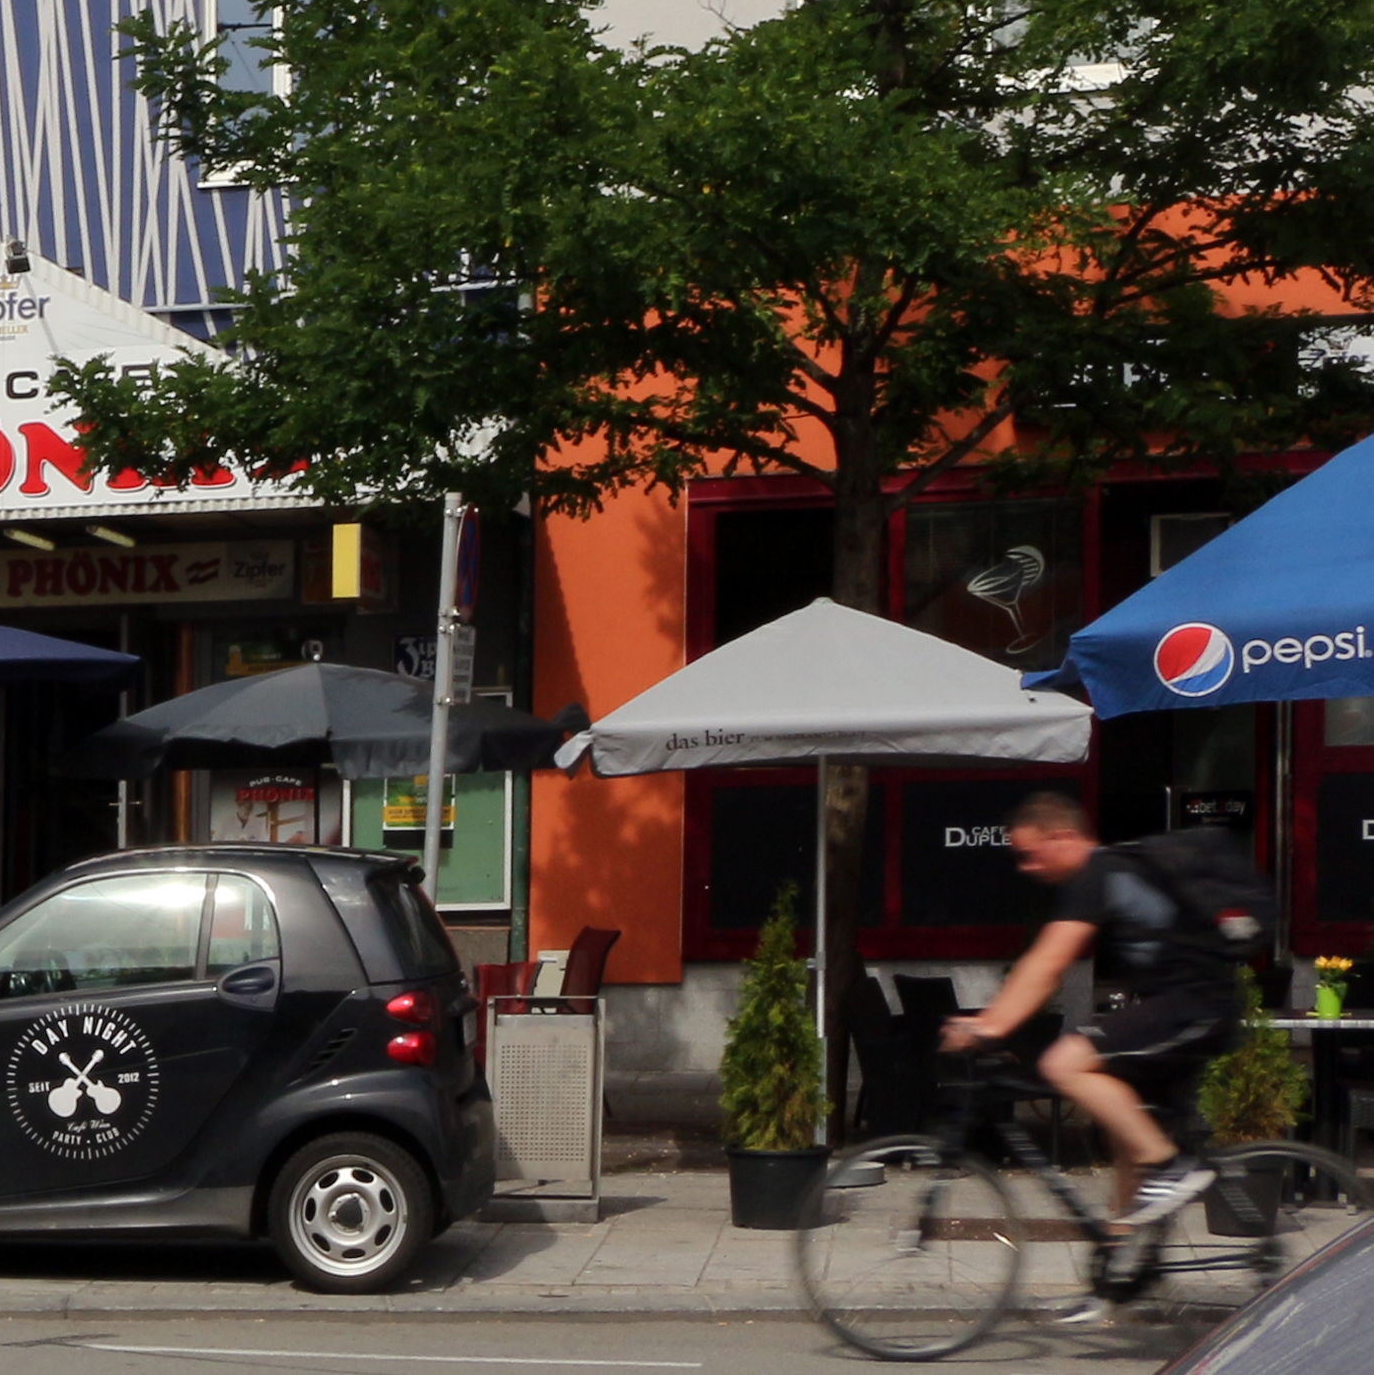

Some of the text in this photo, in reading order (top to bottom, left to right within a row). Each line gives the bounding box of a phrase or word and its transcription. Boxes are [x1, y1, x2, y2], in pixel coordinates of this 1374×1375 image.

[7, 553, 181, 597] PHÖNIX
[234, 560, 286, 582] Zipfer
[1242, 625, 1365, 674] pepsi
[666, 733, 698, 751] das
[704, 728, 744, 747] bier
[944, 827, 1013, 847] DUPLE
[31, 1016, 137, 1055] DAY NIGHT
[28, 1073, 140, 1093] SEIT 2012
[52, 1131, 81, 1145] PARTY
